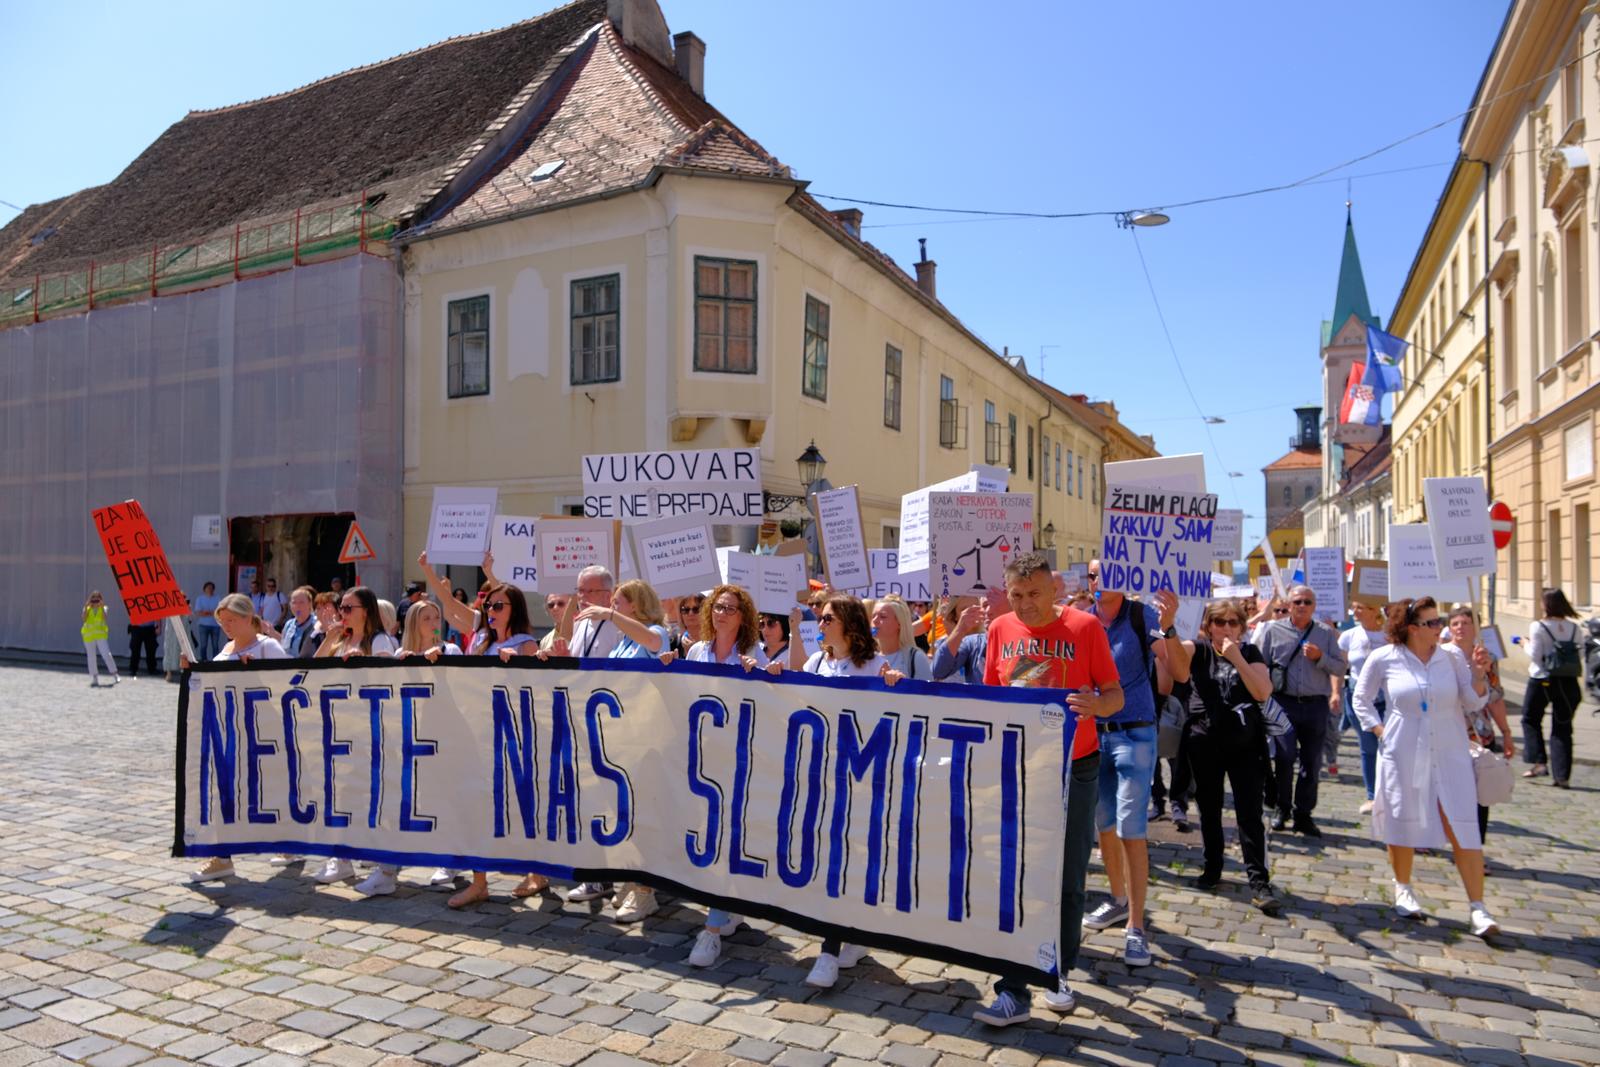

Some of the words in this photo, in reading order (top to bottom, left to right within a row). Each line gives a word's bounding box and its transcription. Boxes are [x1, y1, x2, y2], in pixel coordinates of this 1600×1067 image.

[585, 452, 755, 482] VUKOVAR
[584, 495, 613, 518] SE
[620, 494, 648, 517] NE
[658, 492, 763, 517] PREDAJE
[933, 496, 953, 505] KADA
[956, 495, 998, 507] NEPRAVDA
[1001, 496, 1032, 508] POSTANE
[933, 508, 963, 519] ZAKON
[1111, 488, 1165, 514] ŽELIM
[1169, 494, 1219, 518] PLAĆU
[93, 506, 123, 532] ZA
[938, 520, 974, 531] POSTAJE
[1109, 515, 1164, 538] KAKVU
[1173, 516, 1214, 543] SAM
[108, 535, 128, 557] JE
[648, 538, 677, 549] Vukovar
[671, 548, 684, 556] kad
[1104, 535, 1129, 562] NA
[1135, 539, 1187, 567] TV-u
[1101, 563, 1144, 591] VIDIO
[1150, 569, 1175, 594] DA
[1178, 570, 1212, 598] IMAM
[1000, 638, 1076, 662] MARLIN
[200, 671, 438, 833] NEĆETE
[492, 685, 635, 847] NAS
[685, 694, 1025, 934] SLOMITI
